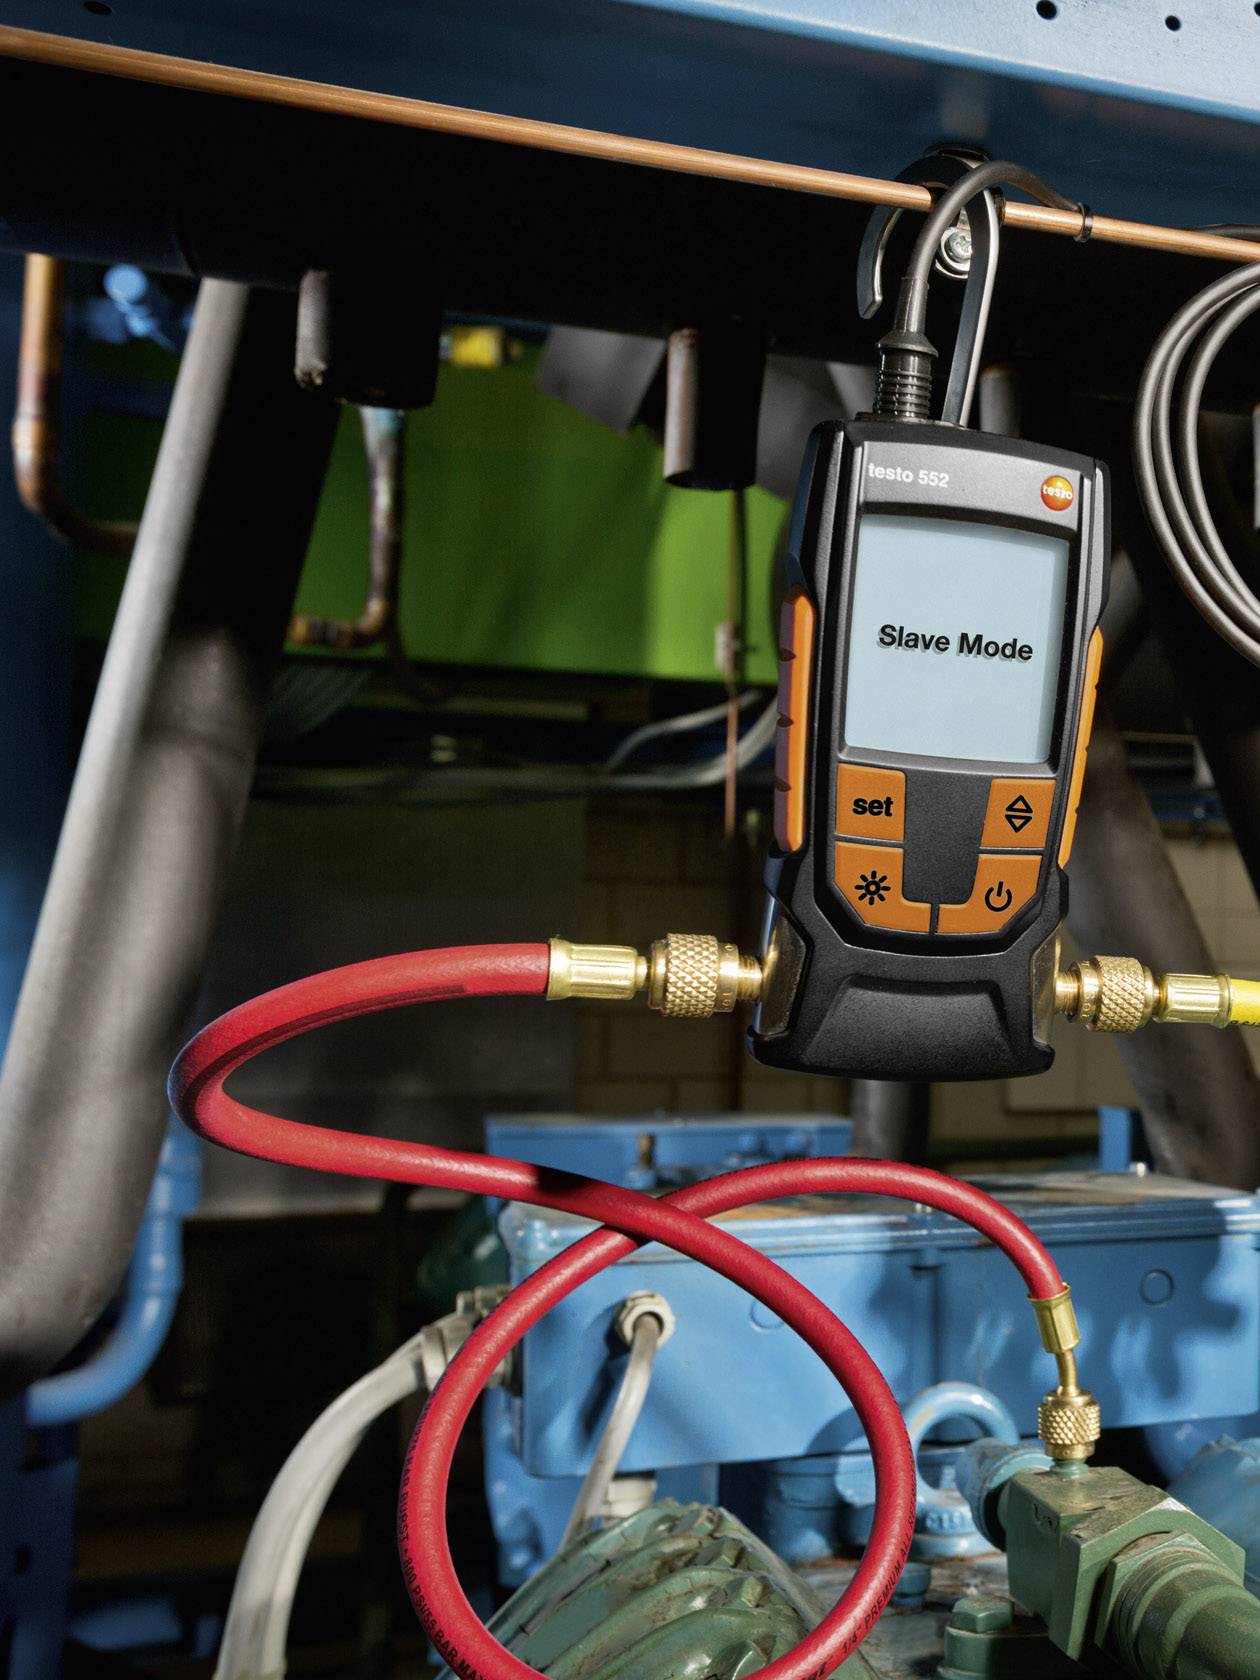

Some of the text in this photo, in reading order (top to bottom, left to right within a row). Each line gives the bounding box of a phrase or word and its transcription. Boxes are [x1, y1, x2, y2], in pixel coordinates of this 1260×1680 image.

[868, 462, 950, 488] testo 552
[1042, 484, 1073, 500] testo
[878, 623, 1034, 661] Slave Mode
[852, 795, 894, 819] set
[865, 1560, 904, 1630] PREMIUM
[434, 1629, 458, 1660] BAR
